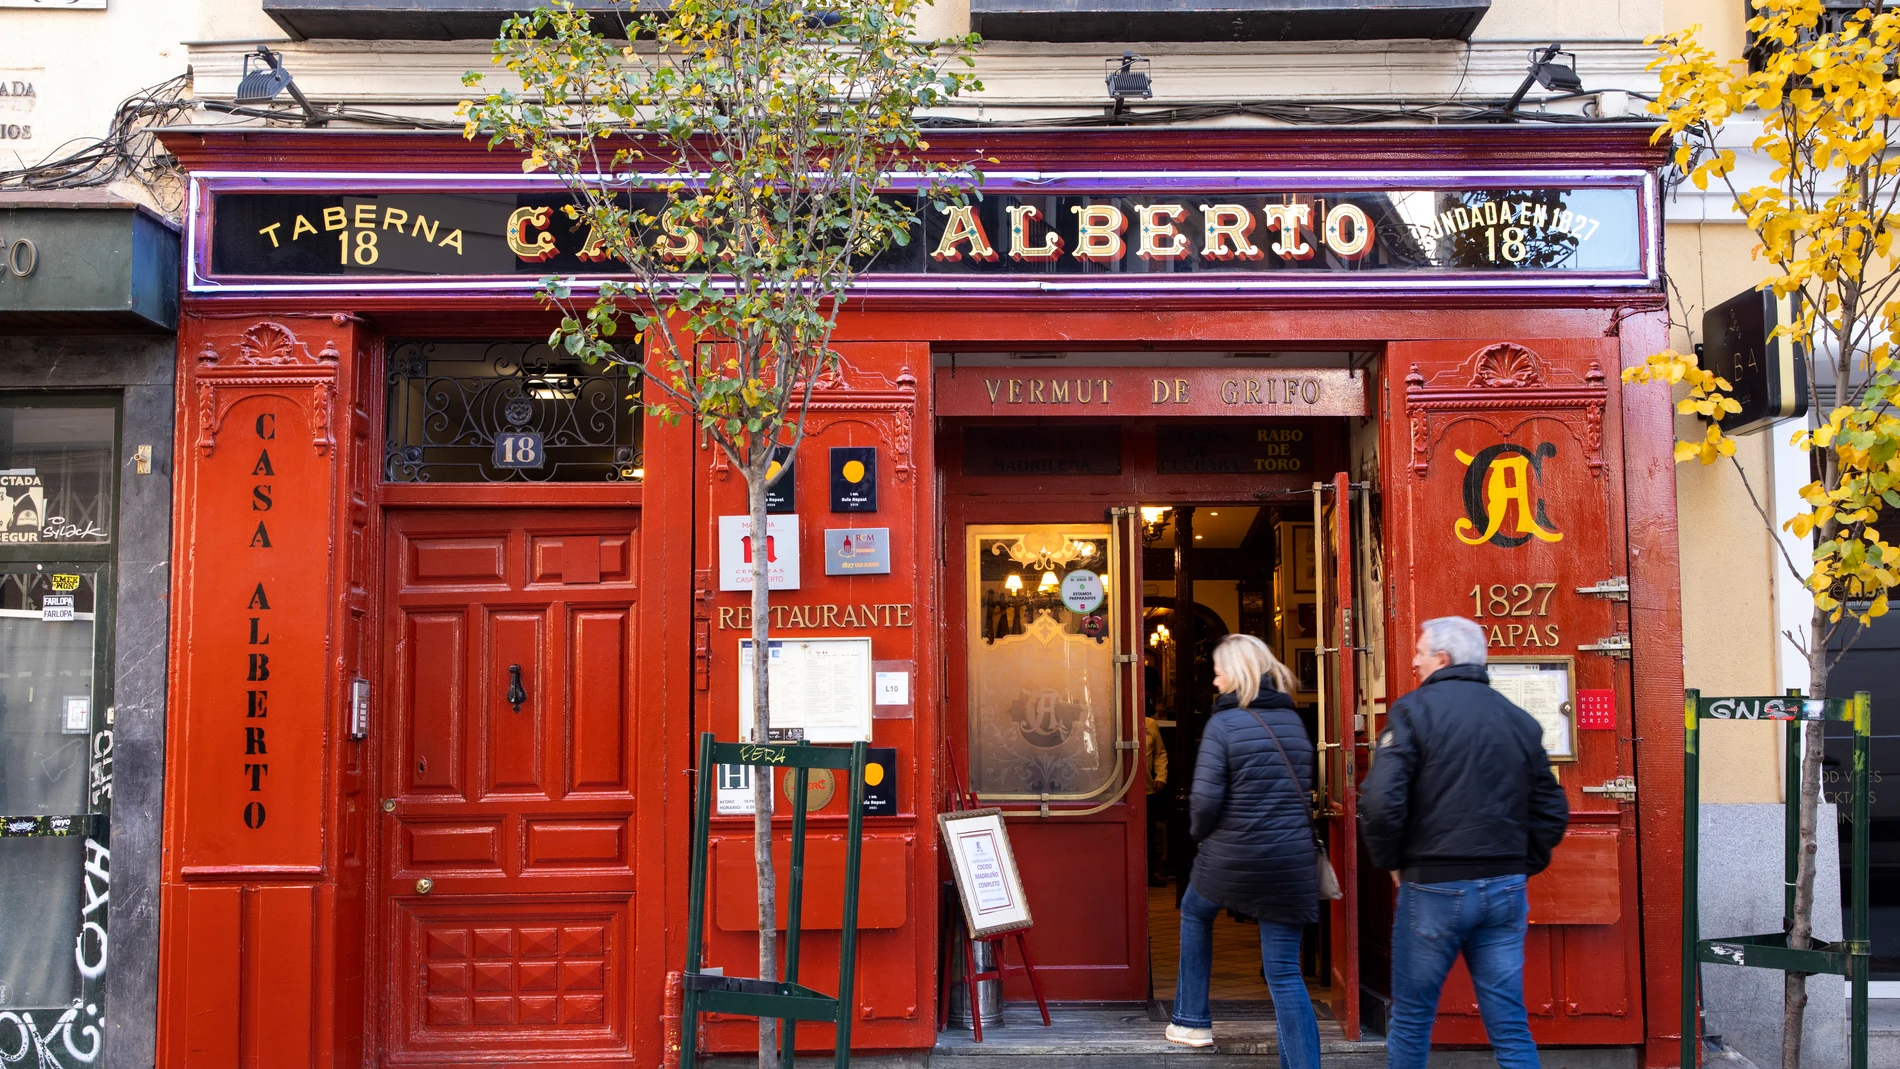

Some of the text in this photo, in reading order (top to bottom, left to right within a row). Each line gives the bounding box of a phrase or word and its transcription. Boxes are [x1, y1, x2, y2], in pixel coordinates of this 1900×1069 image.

[259, 204, 463, 255] TABERNA
[930, 203, 1375, 262] ALBERTO
[1520, 202, 1547, 228] EN
[1550, 207, 1601, 242] 1827
[338, 230, 379, 265] 18
[1485, 227, 1526, 262] 18
[983, 378, 1322, 405] VERMUT DE GRIFO
[503, 436, 536, 463] 18
[1257, 429, 1304, 442] RABO
[1267, 444, 1291, 456] DE
[1254, 459, 1302, 471] TORO
[44, 610, 73, 618] FARLOPA
[1469, 582, 1557, 618] 1827
[243, 412, 275, 829] CASA ALBERTO
[718, 604, 913, 630] RETAURANTE
